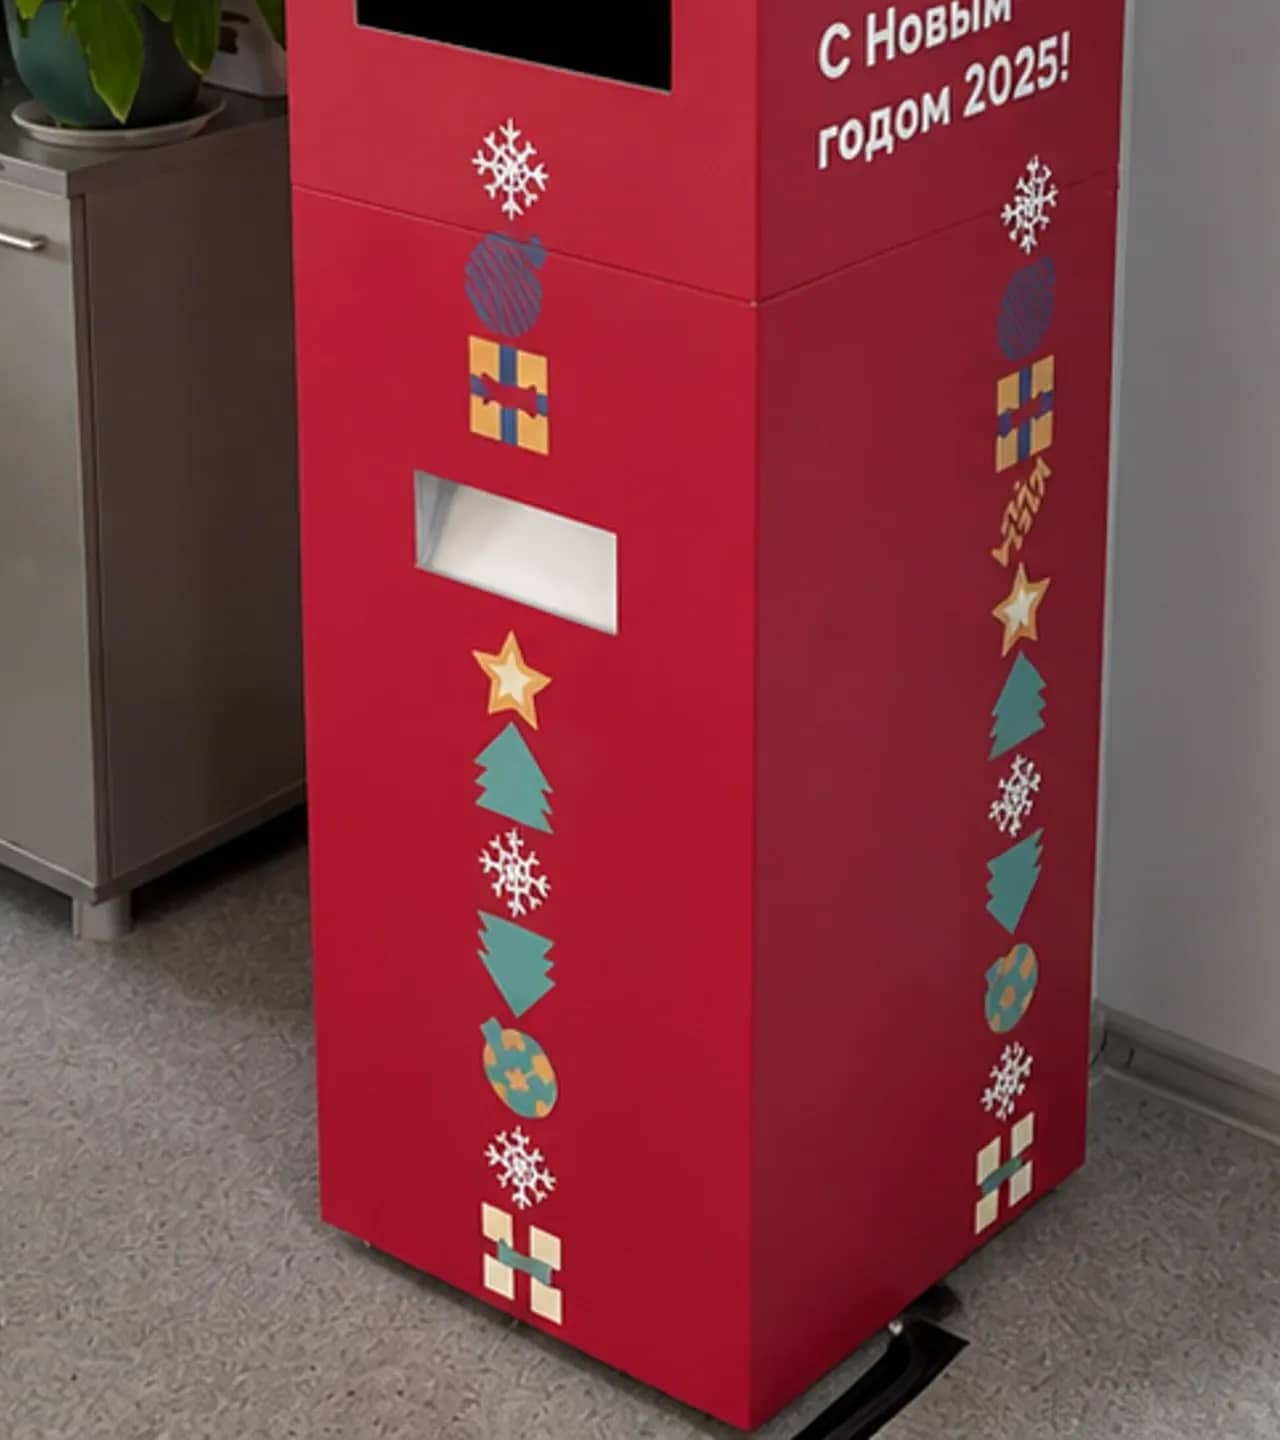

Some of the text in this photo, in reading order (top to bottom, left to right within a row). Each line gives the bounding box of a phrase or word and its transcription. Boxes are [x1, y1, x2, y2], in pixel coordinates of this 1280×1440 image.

[817, 30, 1071, 170] годом 2025!
[818, 21, 852, 80] С
